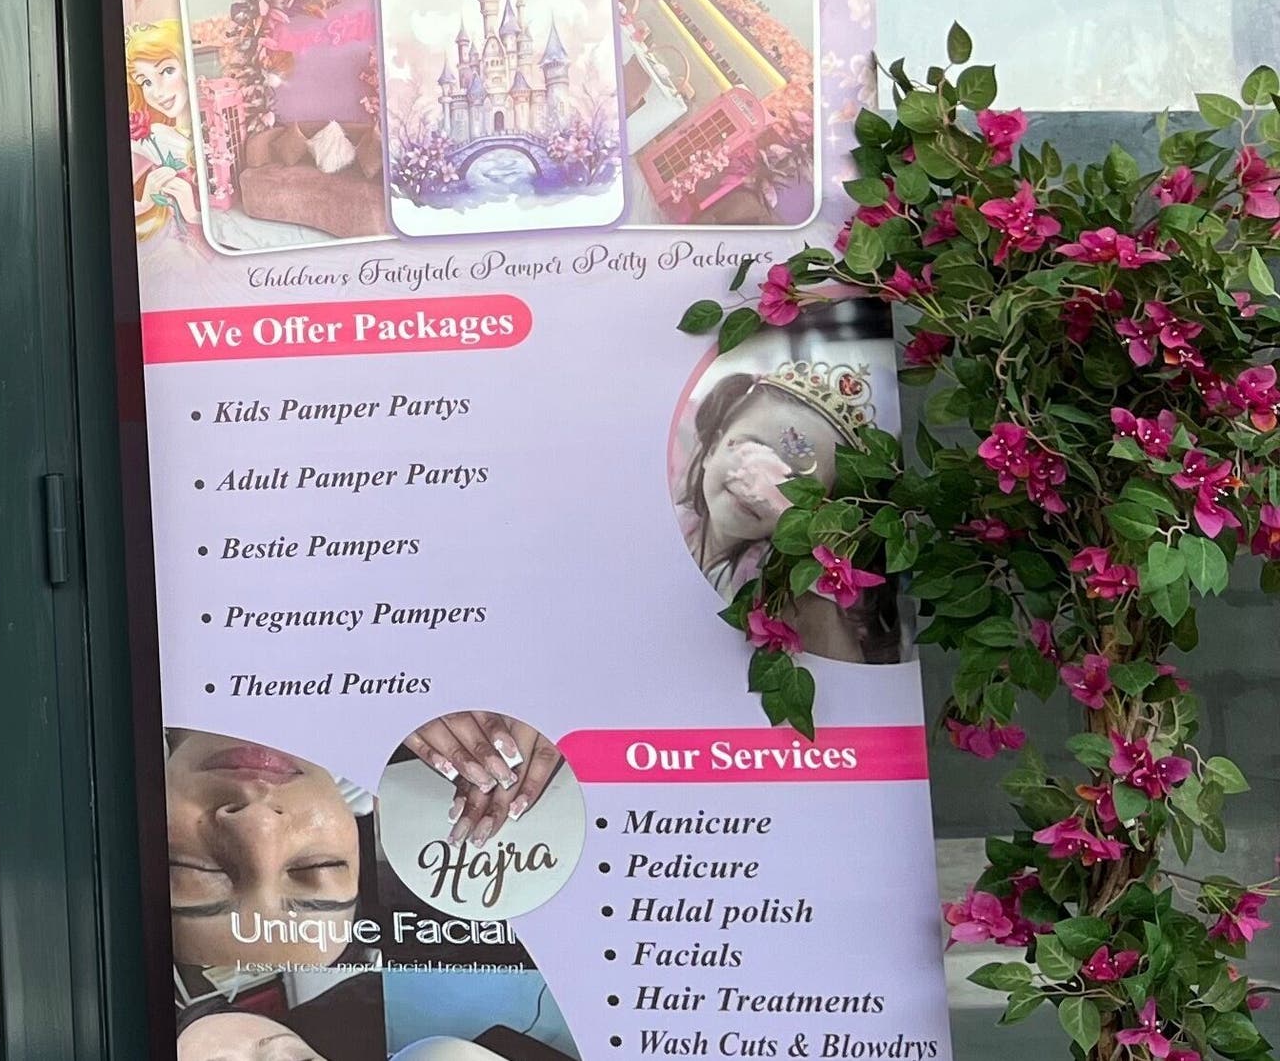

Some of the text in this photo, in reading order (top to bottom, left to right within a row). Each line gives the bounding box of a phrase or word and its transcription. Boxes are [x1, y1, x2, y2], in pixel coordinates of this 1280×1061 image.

[358, 258, 462, 291] Fairytale
[470, 250, 564, 281] Pamper
[572, 243, 648, 279] Party
[187, 311, 515, 349] We Offer Packages
[213, 394, 471, 425] Kids Pamper Partys
[216, 462, 489, 493] Adult Pamper Partys
[221, 534, 420, 562] Bestie Pampers
[224, 602, 487, 633] Pregnancy Pampers
[229, 671, 431, 697] Themed Parties
[625, 740, 856, 772] Our Services
[622, 808, 773, 836] Manicure
[417, 838, 558, 907] Hajra
[625, 853, 760, 881] Pedicure
[628, 897, 813, 930] Halal polish
[231, 911, 517, 953] Unique Facial
[632, 942, 743, 968] Facials
[633, 986, 885, 1014] Hair Treatments
[640, 1030, 938, 1061] Wash Cuts & Blowdrys
